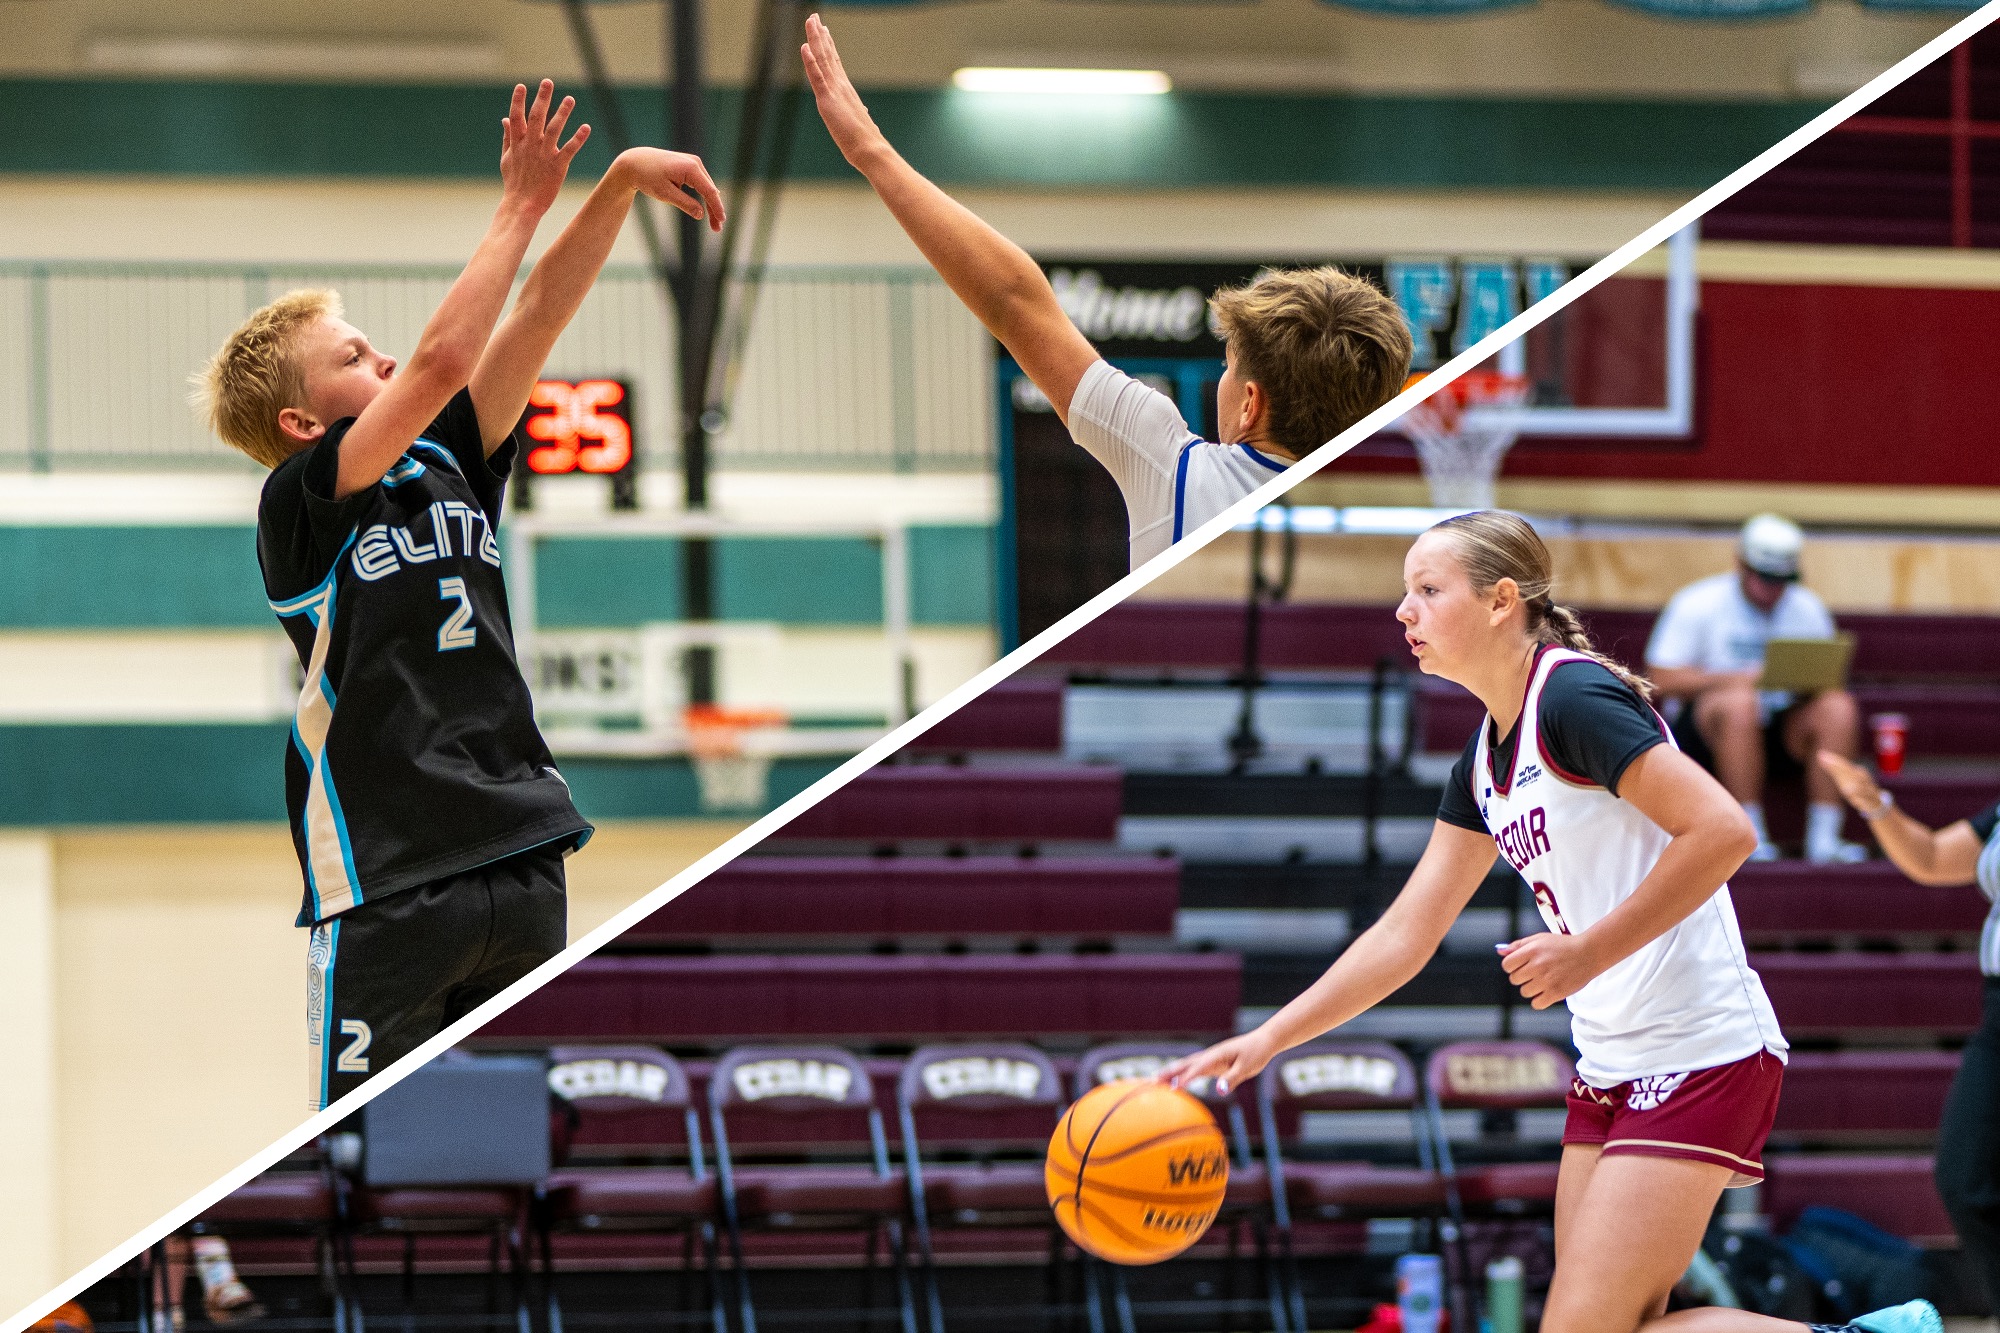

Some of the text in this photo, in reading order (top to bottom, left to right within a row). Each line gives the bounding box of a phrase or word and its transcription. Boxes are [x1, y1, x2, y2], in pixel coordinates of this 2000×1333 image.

[525, 380, 633, 474] 35
[351, 500, 501, 582] ELITE
[437, 575, 477, 652] 2
[336, 1018, 373, 1073] 2
[547, 1058, 668, 1101] CEDAR
[733, 1058, 851, 1101] CEDAR
[922, 1056, 1041, 1099] CEDAR
[1281, 1054, 1397, 1097] CEDAR
[1448, 1052, 1555, 1095] CEDAR
